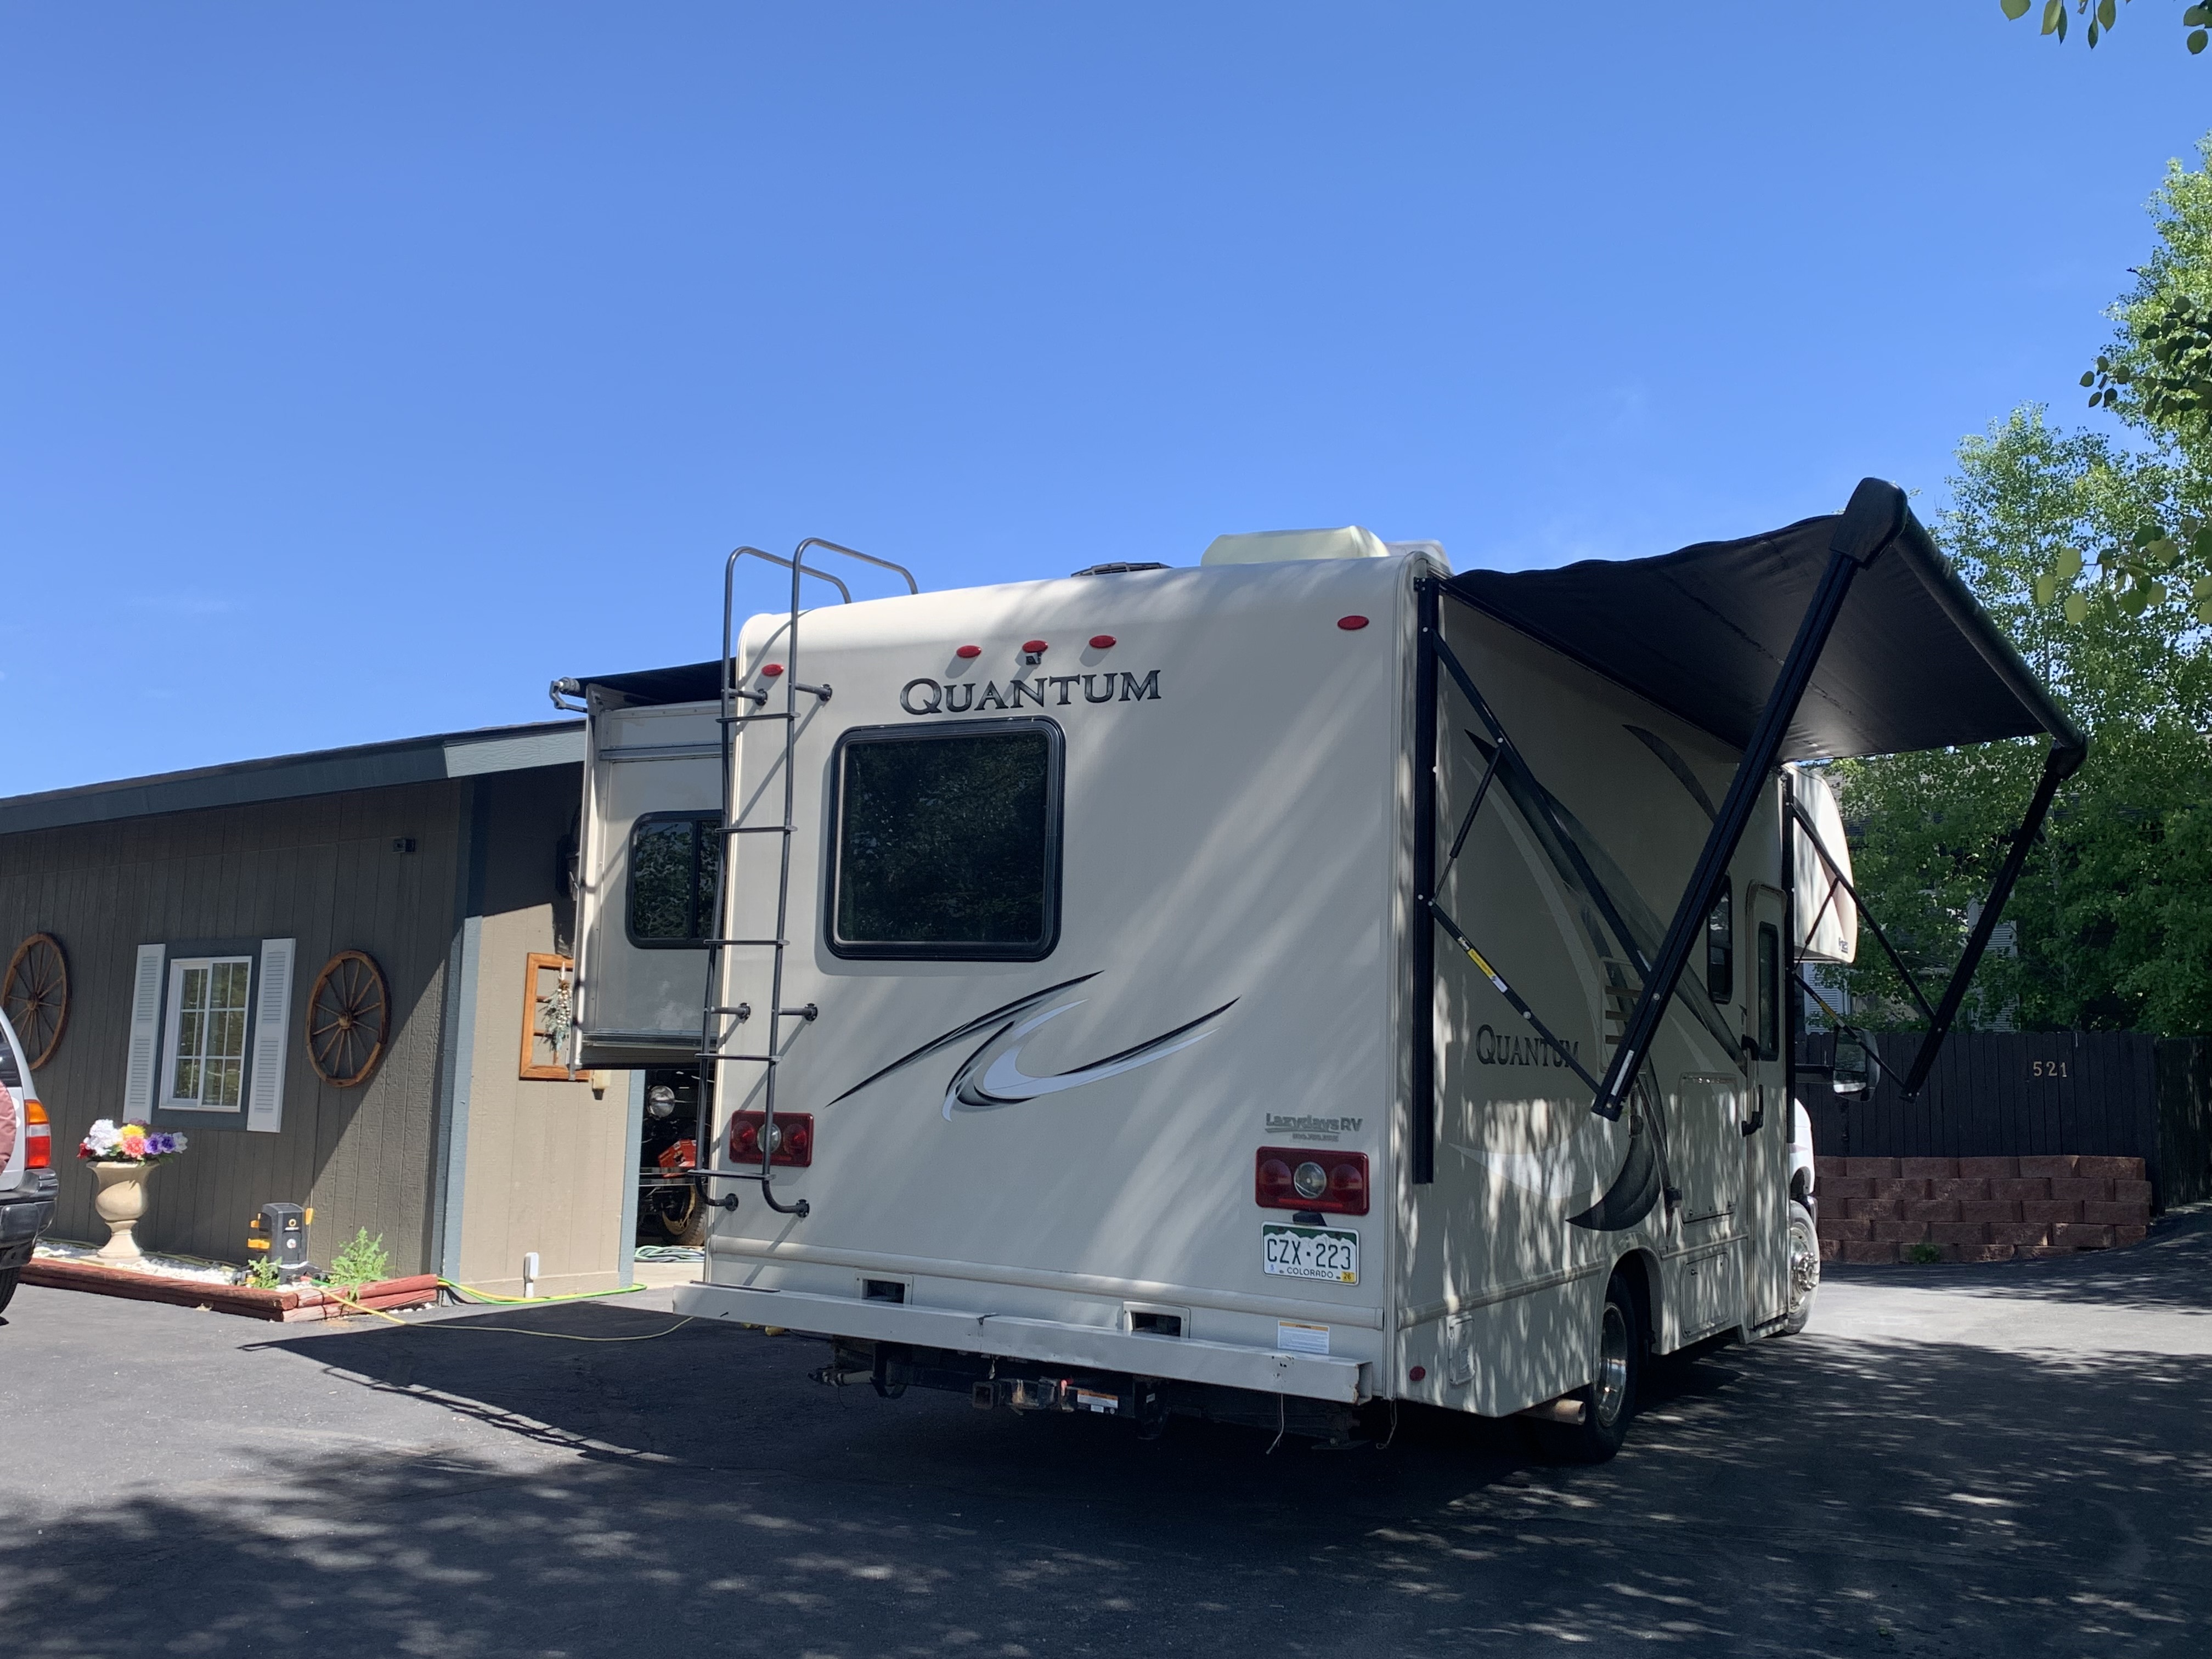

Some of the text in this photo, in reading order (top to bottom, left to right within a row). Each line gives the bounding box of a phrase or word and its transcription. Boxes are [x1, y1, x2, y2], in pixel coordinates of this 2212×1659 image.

[899, 670, 1162, 715] QUANTUM
[2033, 1061, 2068, 1077] 521
[1286, 1267, 1334, 1278] COLORADO
